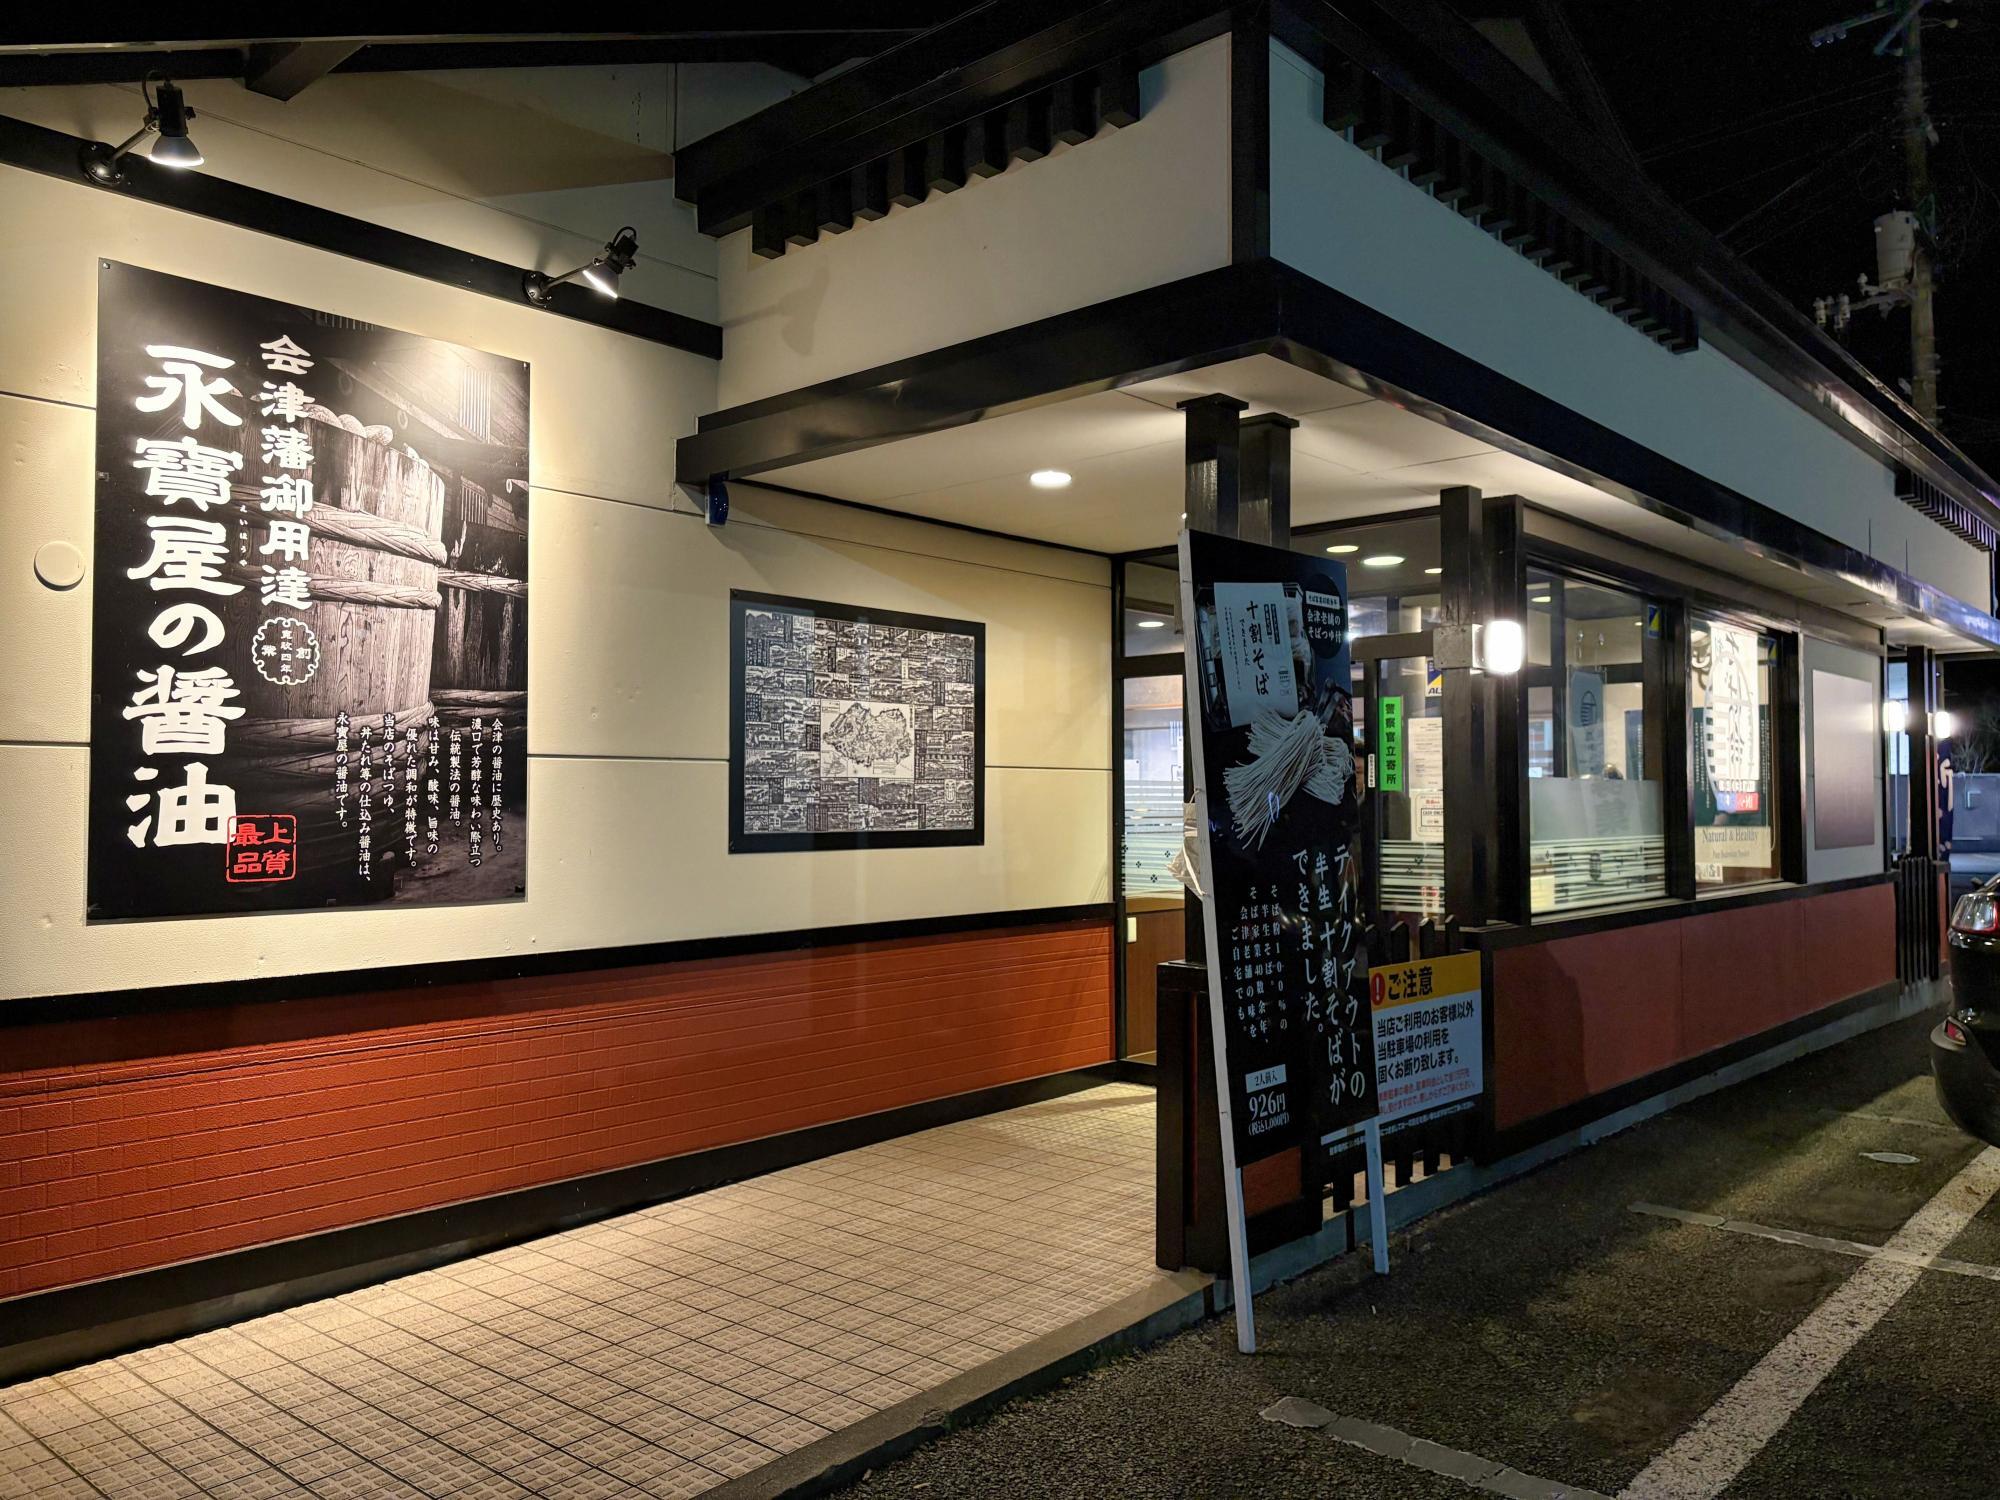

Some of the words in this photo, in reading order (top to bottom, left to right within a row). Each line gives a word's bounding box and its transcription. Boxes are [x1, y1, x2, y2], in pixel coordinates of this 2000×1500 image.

[258, 334, 315, 611] 会津藩御用達
[239, 504, 249, 567] えいほうや
[1246, 600, 1270, 696] 十割そば
[383, 713, 396, 814] 当店のそばつゆ、
[449, 729, 462, 827] 伝統製法の醤油。
[469, 718, 483, 867] 濃口で芳醇な味わい際立つ
[491, 718, 504, 852] 会津の醤油に歴史あり。
[1385, 703, 1397, 785] 警察官立寄所
[358, 726, 372, 882] 丼たれ等の仕込み醤油は、
[404, 728, 418, 868] 優れた調和が特徴です。
[1702, 828, 1727, 843] Natural
[1292, 848, 1323, 1033] できました。
[1315, 852, 1346, 1106] 半生十割そばが
[1334, 844, 1366, 1098] テイクアウトの
[1388, 966, 1433, 1000] ご注意
[1377, 999, 1474, 1038] 当店ご利用のお客様以外
[1377, 1028, 1449, 1061] 当駐車場の利用を
[1377, 1048, 1459, 1085] 固くお断り致します。
[1248, 1090, 1286, 1121] 926円
